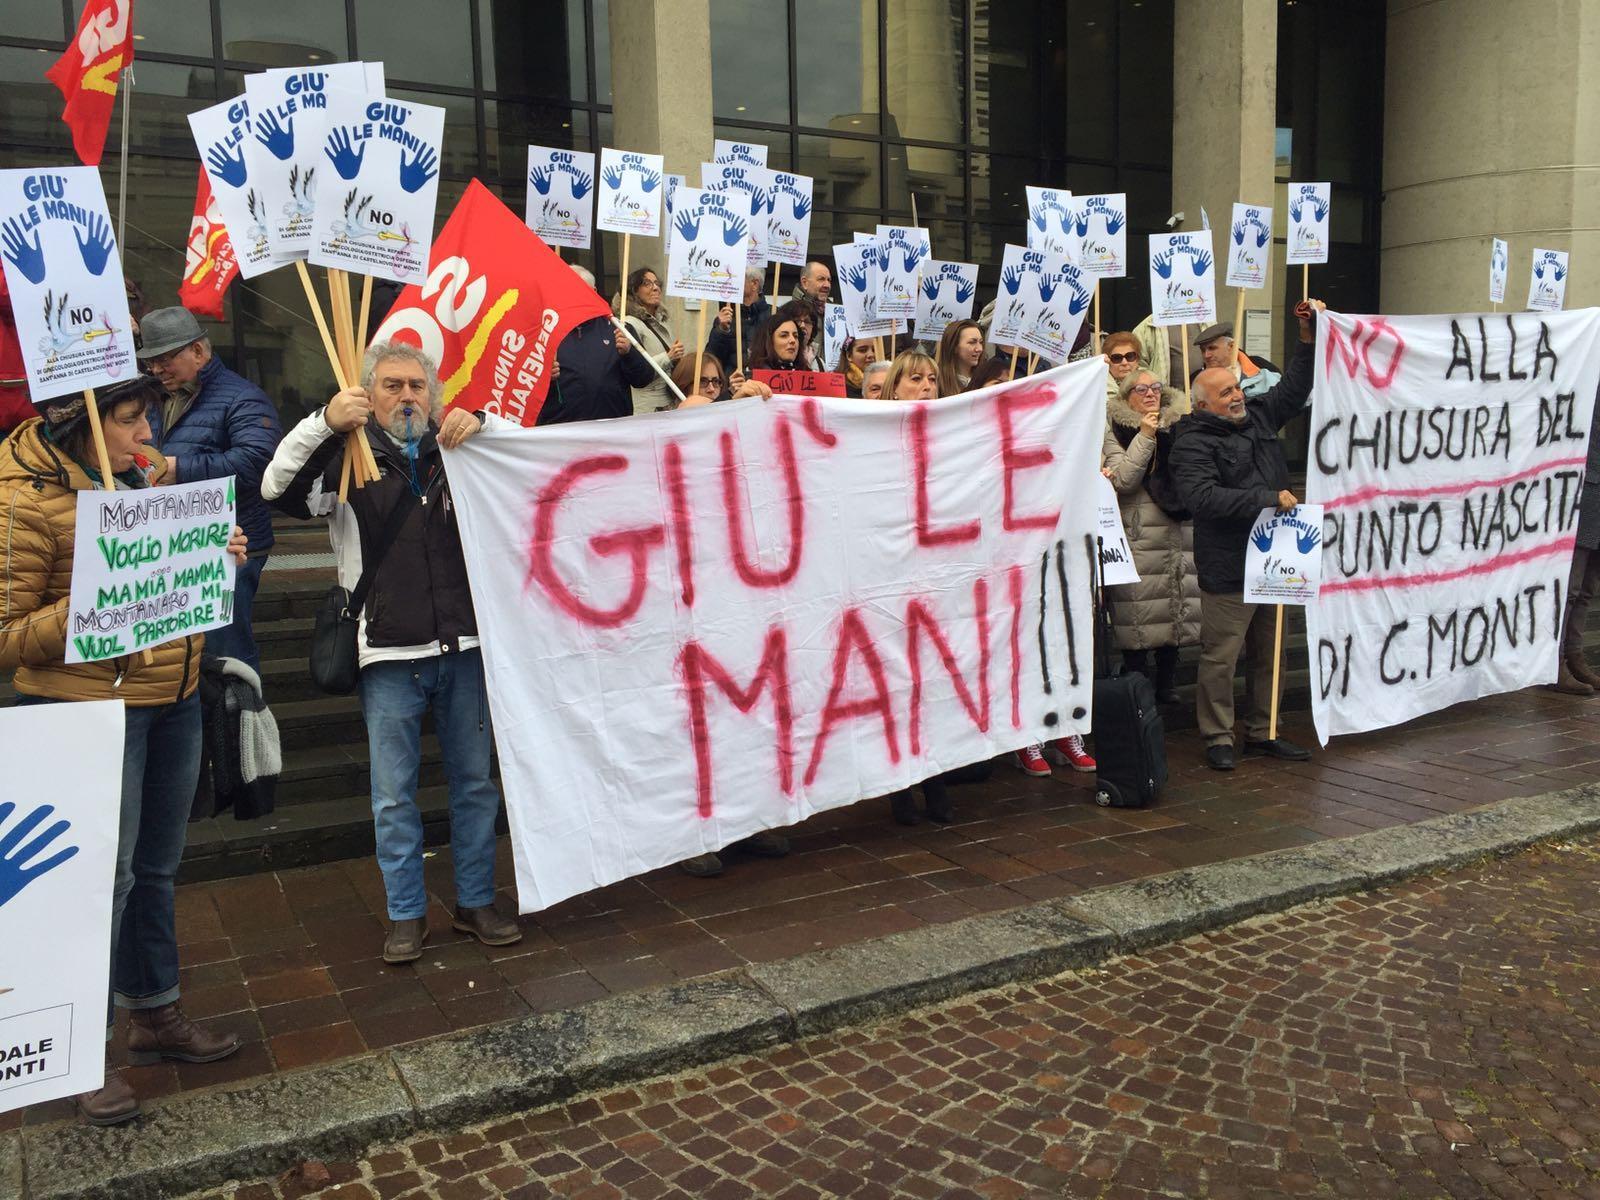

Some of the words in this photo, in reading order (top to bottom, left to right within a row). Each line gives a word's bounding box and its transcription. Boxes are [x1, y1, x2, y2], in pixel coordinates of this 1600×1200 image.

[285, 73, 330, 95] GIU'
[227, 100, 250, 124] GI
[277, 98, 298, 119] LE
[302, 93, 326, 109] MA
[366, 102, 412, 126] GIU'
[224, 126, 244, 149] LE
[353, 124, 373, 141] LE
[379, 124, 419, 153] MANI
[737, 153, 757, 166] MANI
[544, 163, 555, 173] LE
[558, 163, 581, 178] MANI
[615, 163, 625, 172] LE
[628, 163, 651, 175] MANI
[23, 175, 68, 201] GIU'
[717, 180, 728, 191] LE
[731, 179, 754, 193] MANI
[769, 185, 779, 194] LE
[781, 185, 802, 199] MANI
[19, 204, 41, 232] LE
[43, 201, 87, 227] MANI
[370, 209, 393, 226] NO
[557, 210, 570, 218] NO
[692, 206, 705, 218] LE
[708, 206, 735, 222] MANI
[1081, 209, 1091, 217] LE
[1094, 206, 1115, 217] MANI
[778, 229, 791, 237] NO
[895, 240, 911, 251] MANI
[1164, 248, 1174, 258] LE
[1177, 246, 1200, 255] MANI
[704, 258, 720, 267] NO
[1016, 264, 1026, 274] LE
[1028, 263, 1042, 274] MA
[934, 274, 944, 282] LE
[946, 273, 966, 285] MANI
[1052, 274, 1062, 283] LE
[1065, 277, 1084, 295] MANI
[70, 307, 93, 325] NO
[1048, 320, 1061, 330] NO
[1322, 317, 1404, 388] NO
[1445, 315, 1558, 381] ALLA
[800, 375, 817, 391] LE
[1315, 400, 1510, 475] CHIUSURA
[1536, 391, 1584, 447] DEL
[100, 488, 224, 533] MONTANARO
[527, 398, 836, 628] GIU'
[909, 378, 1061, 547] LE
[1266, 519, 1278, 530] LE
[1281, 518, 1308, 532] MANI
[96, 534, 163, 572] VOGLIO
[168, 521, 229, 558] MORIRE
[173, 555, 227, 590] MAMMA
[1280, 567, 1295, 575] NO
[73, 591, 190, 634] MONTANARO
[201, 583, 221, 601] MI
[73, 634, 125, 661] VUOL
[132, 602, 215, 648] PARTORIRE
[1318, 633, 1353, 700] DI
